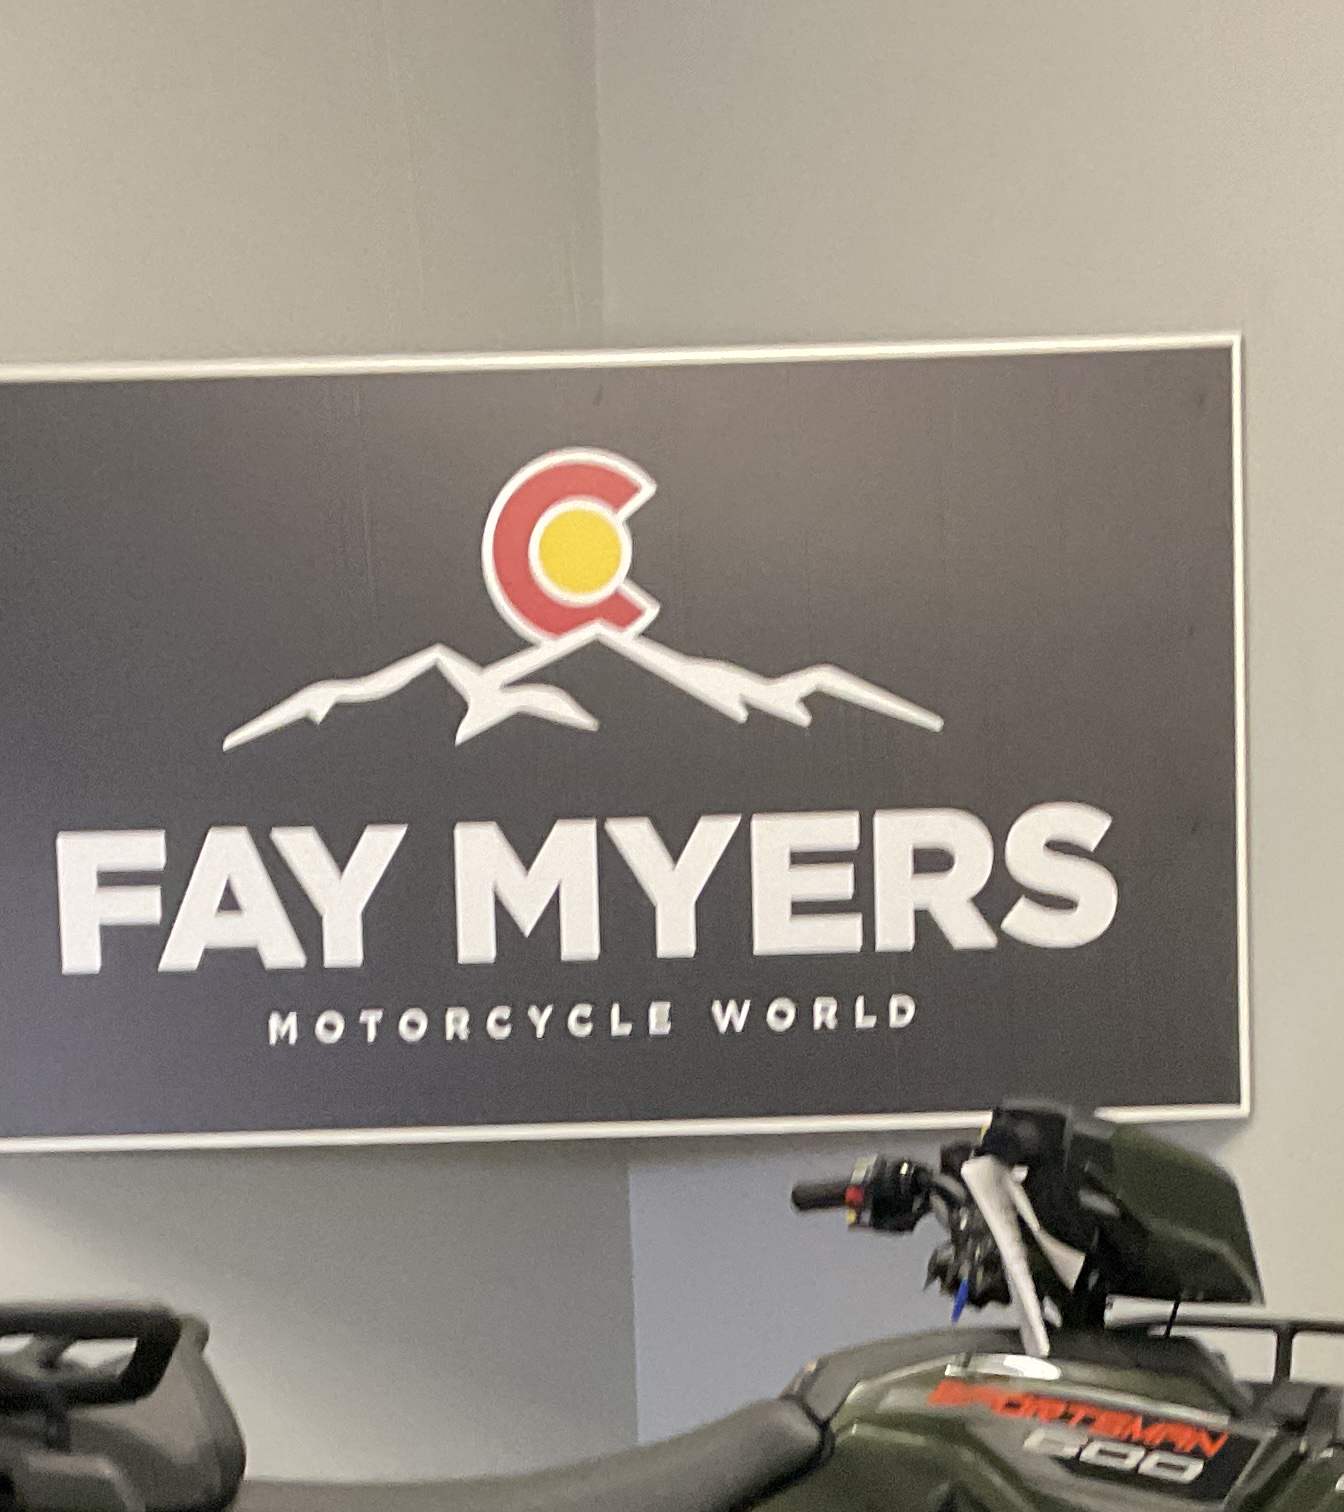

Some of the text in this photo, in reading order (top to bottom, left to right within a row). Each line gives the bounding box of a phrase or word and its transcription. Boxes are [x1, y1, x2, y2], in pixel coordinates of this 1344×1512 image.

[56, 803, 1117, 974] FAY MYERS
[269, 995, 915, 1045] MOTORCYCLE WORLD
